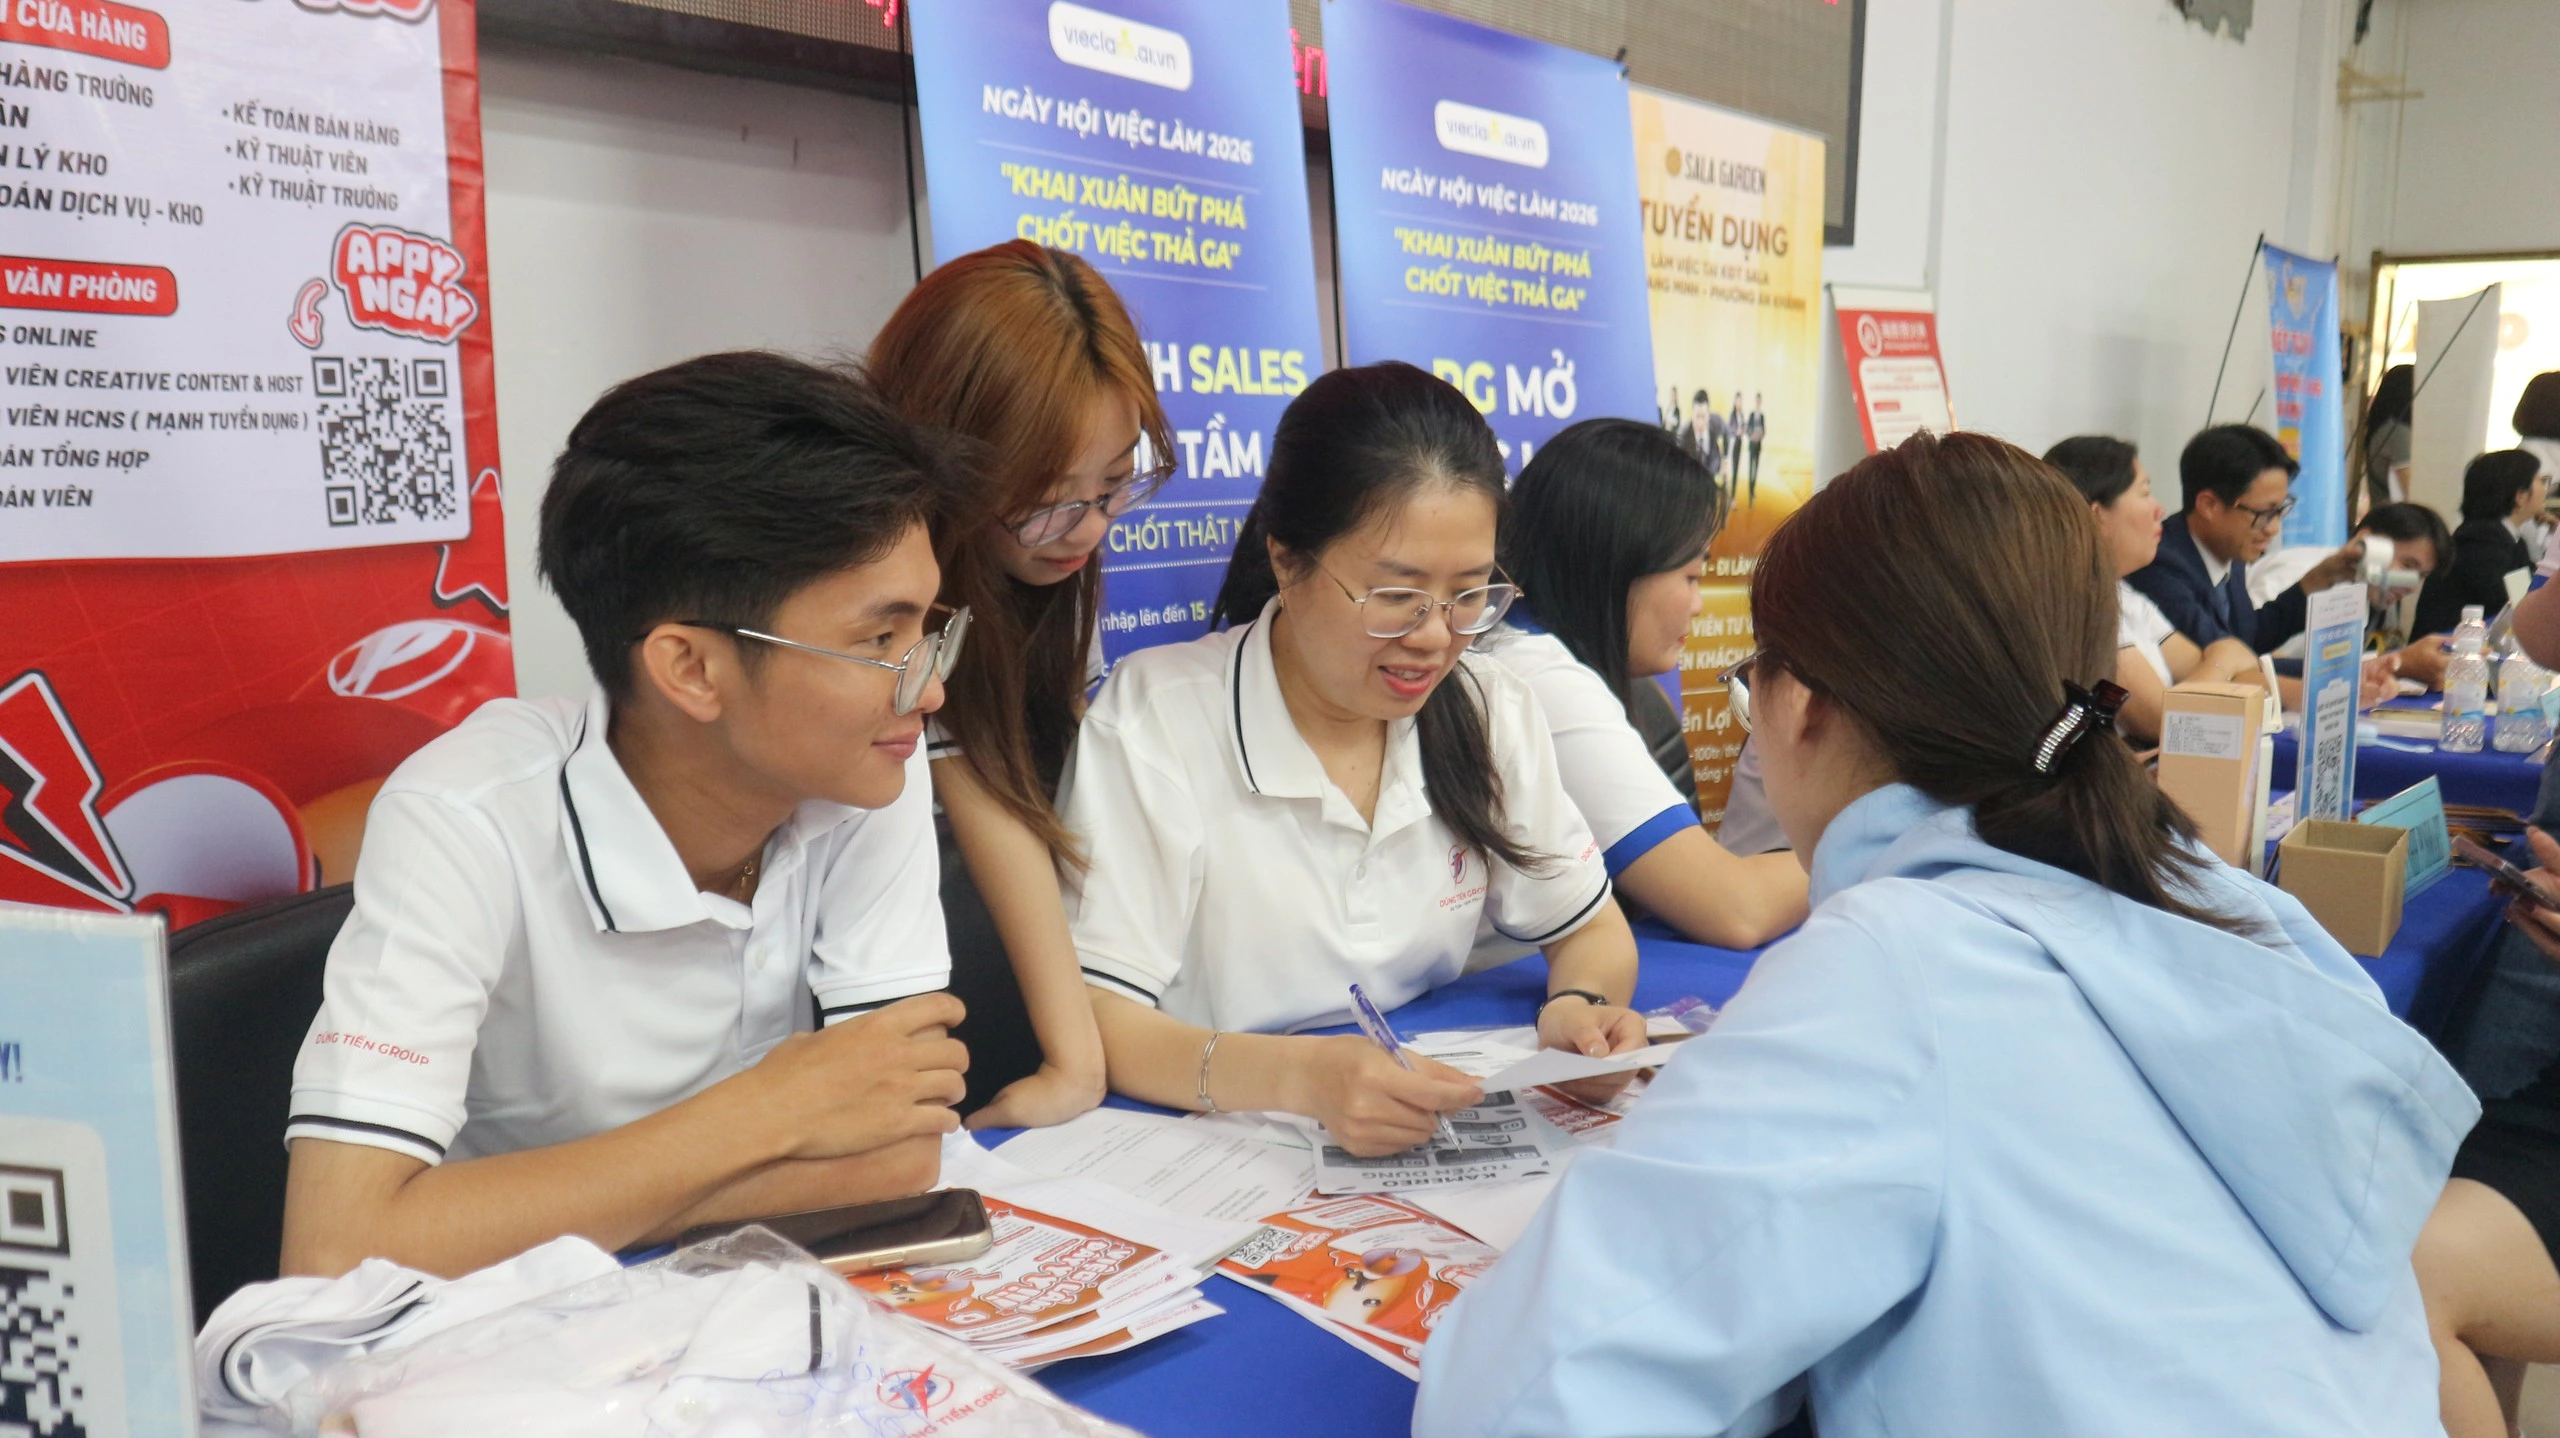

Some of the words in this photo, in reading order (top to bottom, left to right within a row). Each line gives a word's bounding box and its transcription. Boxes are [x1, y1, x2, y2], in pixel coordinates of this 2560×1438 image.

[80, 9, 148, 51] HÀNG
[233, 98, 260, 127] KẾ
[263, 107, 310, 135] TOÁN
[314, 114, 350, 140] BÁN
[354, 122, 400, 147] HÀNG
[982, 84, 1052, 124] NGÀY
[1056, 104, 1099, 140] HỘI
[1104, 111, 1154, 150] VIỆC
[1159, 119, 1204, 156] LÀM
[1207, 134, 1253, 166] 2026
[16, 142, 50, 171] LÝ
[58, 150, 108, 176] KHO
[236, 136, 261, 162] KỸ
[266, 142, 324, 175] THUẬT
[329, 150, 368, 176] VIÊN
[1684, 151, 1715, 186] SALA
[1719, 160, 1767, 195] GARDEN
[60, 190, 118, 222] DỊCH
[124, 195, 151, 226] VỤ
[168, 201, 204, 226] KHO
[239, 172, 264, 198] KỸ
[269, 177, 327, 209] THUẬT
[1001, 161, 1075, 202] "KHAI
[1080, 171, 1148, 215] XUÂN
[1152, 183, 1198, 224] BỨT
[1202, 194, 1248, 230] PHÁ
[1381, 167, 1437, 195] NGÀY
[1439, 176, 1473, 209] HỘI
[1477, 183, 1517, 215] VIỆC
[1519, 191, 1557, 220] LÀM
[1559, 200, 1598, 227] 2026
[1016, 211, 1089, 252] CHỐT
[1093, 219, 1149, 265] VIỆC
[1151, 230, 1198, 266] THẢ
[1456, 235, 1510, 266] XUÂN
[1513, 240, 1552, 273] BỨT
[1552, 249, 1592, 280] PHÁ
[1722, 216, 1789, 262] DỤNG
[346, 232, 457, 288] APPY
[3, 264, 64, 298] VĂN
[68, 271, 158, 304] PHÒNG
[357, 274, 470, 329] NGAY
[1405, 264, 1463, 297] CHỐT
[1466, 271, 1508, 308] VIỆC
[1511, 278, 1549, 308] THẢ
[13, 325, 98, 349] ONLINE
[6, 363, 59, 388] VIÊN
[64, 367, 172, 391] CREATIVE
[176, 373, 250, 393] CONTENT
[253, 376, 264, 393] &
[268, 375, 304, 394] HOST
[1140, 340, 1183, 393] H
[1187, 343, 1309, 398] SALES
[1505, 348, 1578, 420] MỞ
[7, 404, 59, 428] VIÊN
[64, 409, 126, 430] HCNS
[146, 411, 203, 435] MẠNH
[209, 404, 259, 430] TUYỂN
[261, 412, 300, 435] DỤNG
[0, 444, 34, 467] ÁN
[41, 439, 100, 468] TỔNG
[106, 449, 151, 474] HỢP
[1175, 411, 1264, 480] TẦM
[41, 484, 94, 508] VIÊN
[1108, 513, 1172, 553] CHỐT
[1174, 513, 1230, 552] THẬT
[1101, 610, 1138, 634] nhập
[1139, 607, 1161, 627] lên
[1162, 603, 1187, 624] đến
[1189, 600, 1207, 622] 15
[1705, 706, 1732, 736] Lợi
[1467, 885, 1489, 898] GRO
[342, 1034, 376, 1051] TIẾN
[378, 1042, 430, 1066] GROUP
[974, 1387, 1007, 1408] GRO
